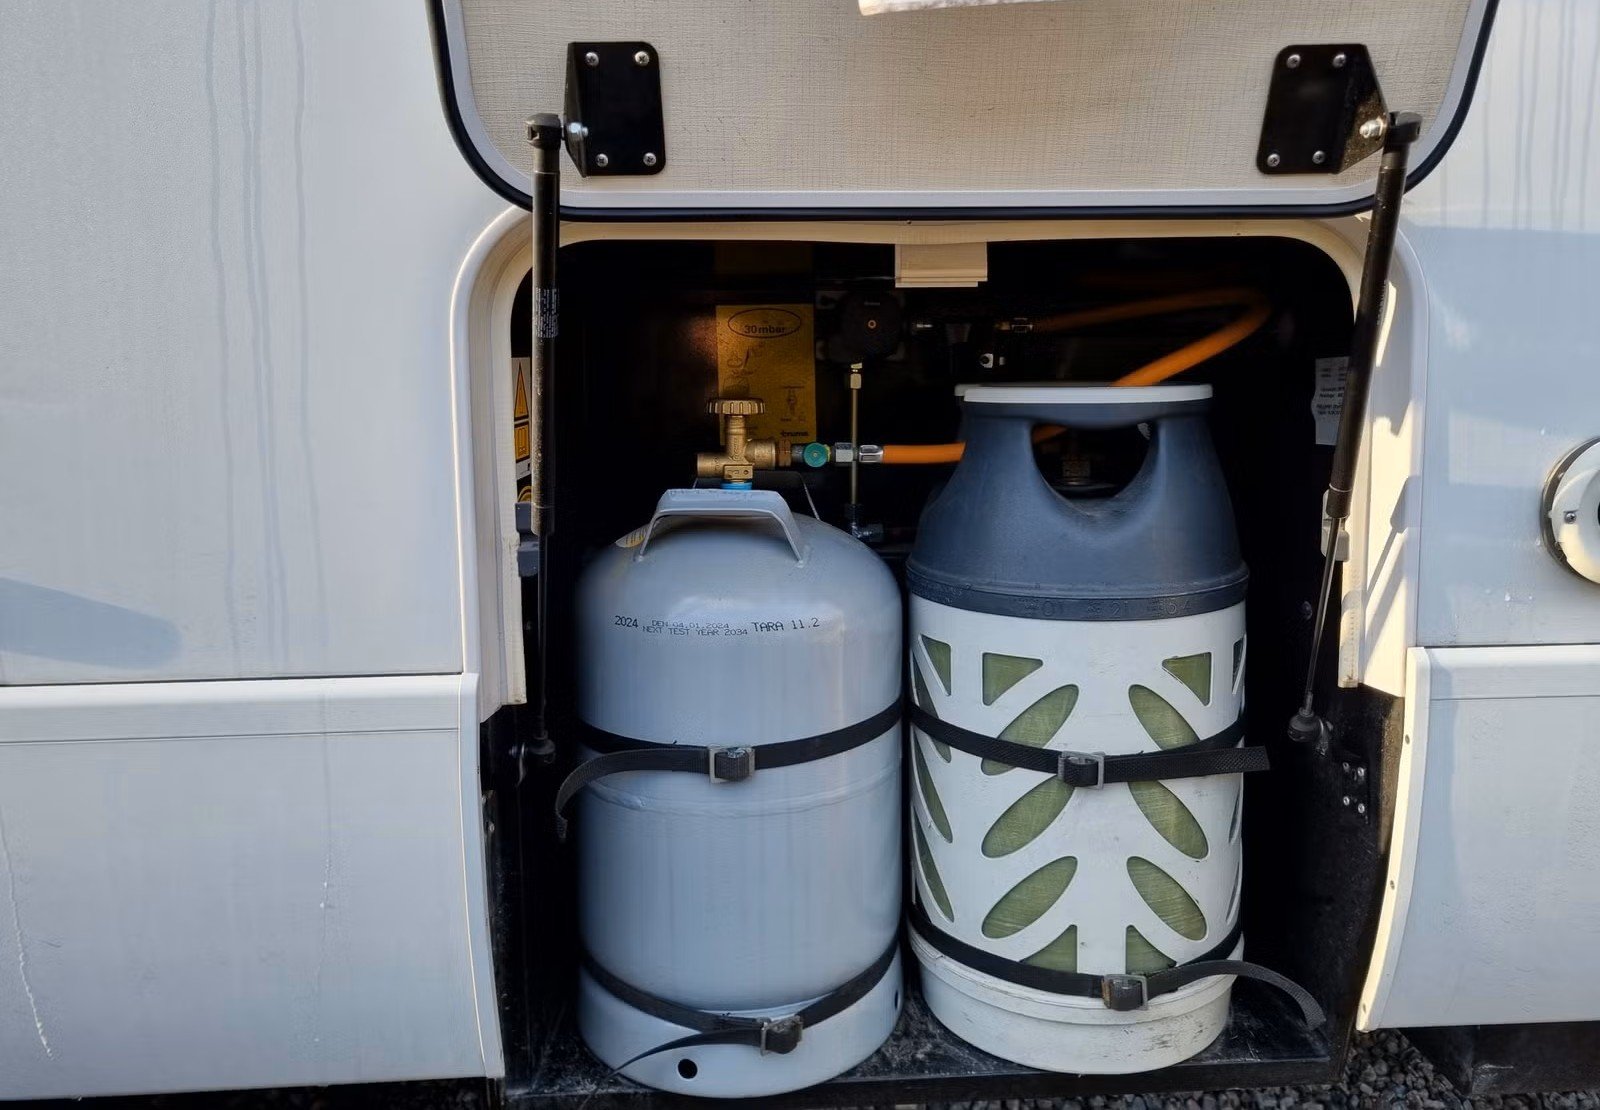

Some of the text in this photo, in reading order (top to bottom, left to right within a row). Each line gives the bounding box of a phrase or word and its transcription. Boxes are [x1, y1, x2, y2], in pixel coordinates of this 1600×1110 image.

[744, 325, 785, 334] 30 mbar
[614, 615, 638, 628] 2024
[672, 621, 729, 629] 04.01.2024
[751, 617, 820, 632] TARA 11.2
[642, 625, 748, 636] NEXT TEST YEAR 2034
